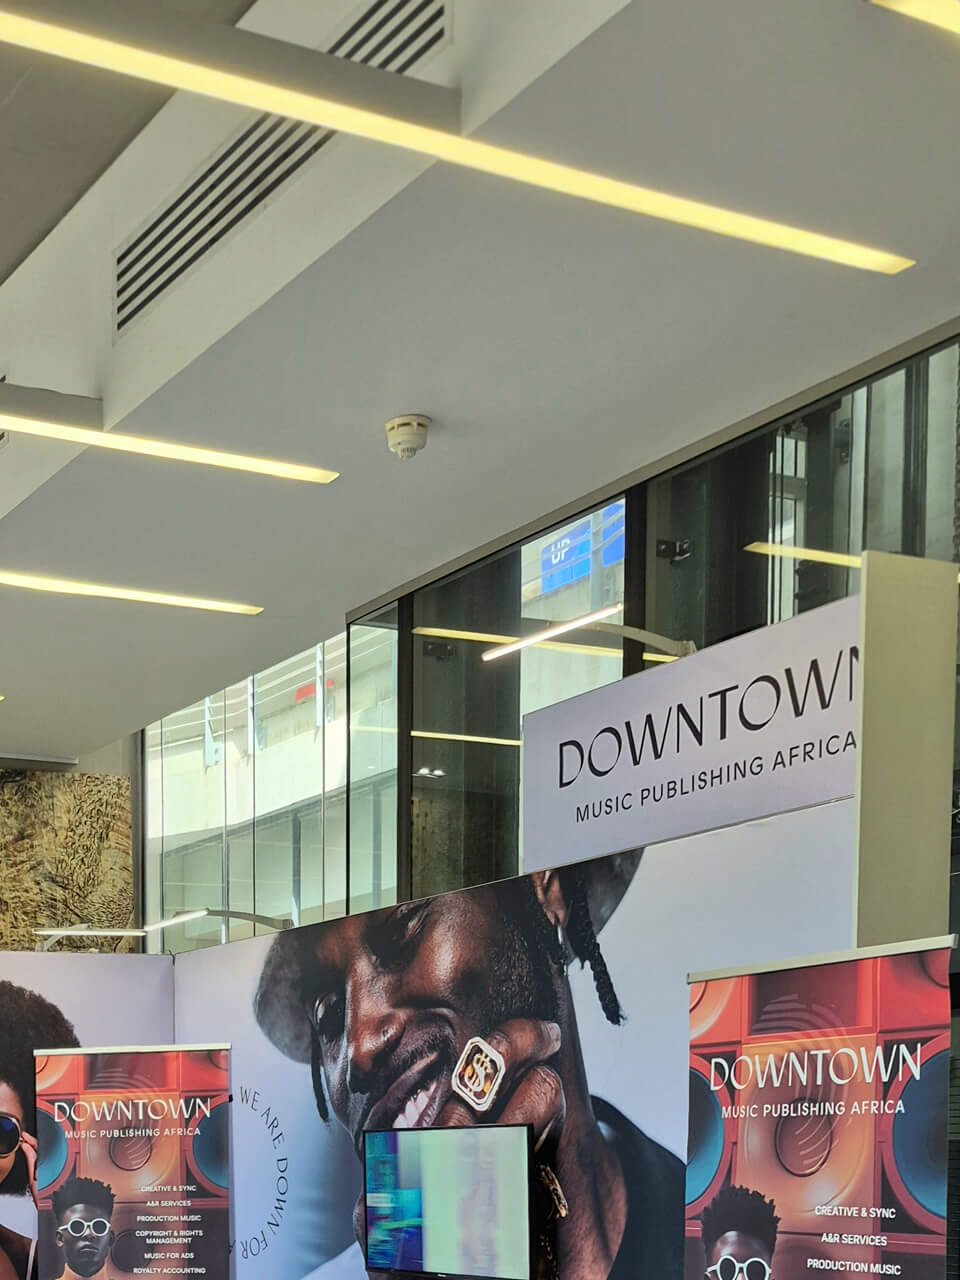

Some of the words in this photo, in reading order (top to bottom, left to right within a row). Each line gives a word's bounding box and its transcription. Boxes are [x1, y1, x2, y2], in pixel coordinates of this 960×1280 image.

[575, 792, 633, 824] MUSIC
[640, 756, 764, 807] PUBLISHING
[772, 730, 857, 772] AFRICA
[710, 1042, 922, 1092] DOWNTOWN
[53, 1097, 212, 1123] DOWNTOWN
[239, 1086, 261, 1112] WE
[721, 1104, 759, 1119] MUSIC
[762, 1101, 846, 1117] PUBLISHING
[850, 1099, 906, 1114] AFRICA
[65, 1129, 97, 1139] MUSIC
[99, 1128, 161, 1138] PUBLISHING
[163, 1127, 201, 1137] AFRICA
[260, 1106, 286, 1150] ARE
[266, 1157, 289, 1236] DOWN
[814, 1206, 859, 1217] CREATIVE
[860, 1207, 868, 1218] &
[869, 1207, 897, 1219] SYNC
[240, 1229, 269, 1260] FOR
[820, 1232, 840, 1244] A&R
[841, 1234, 888, 1246] SERVICES
[806, 1258, 869, 1273] PRODUCTION
[870, 1263, 902, 1276] MUSIC
